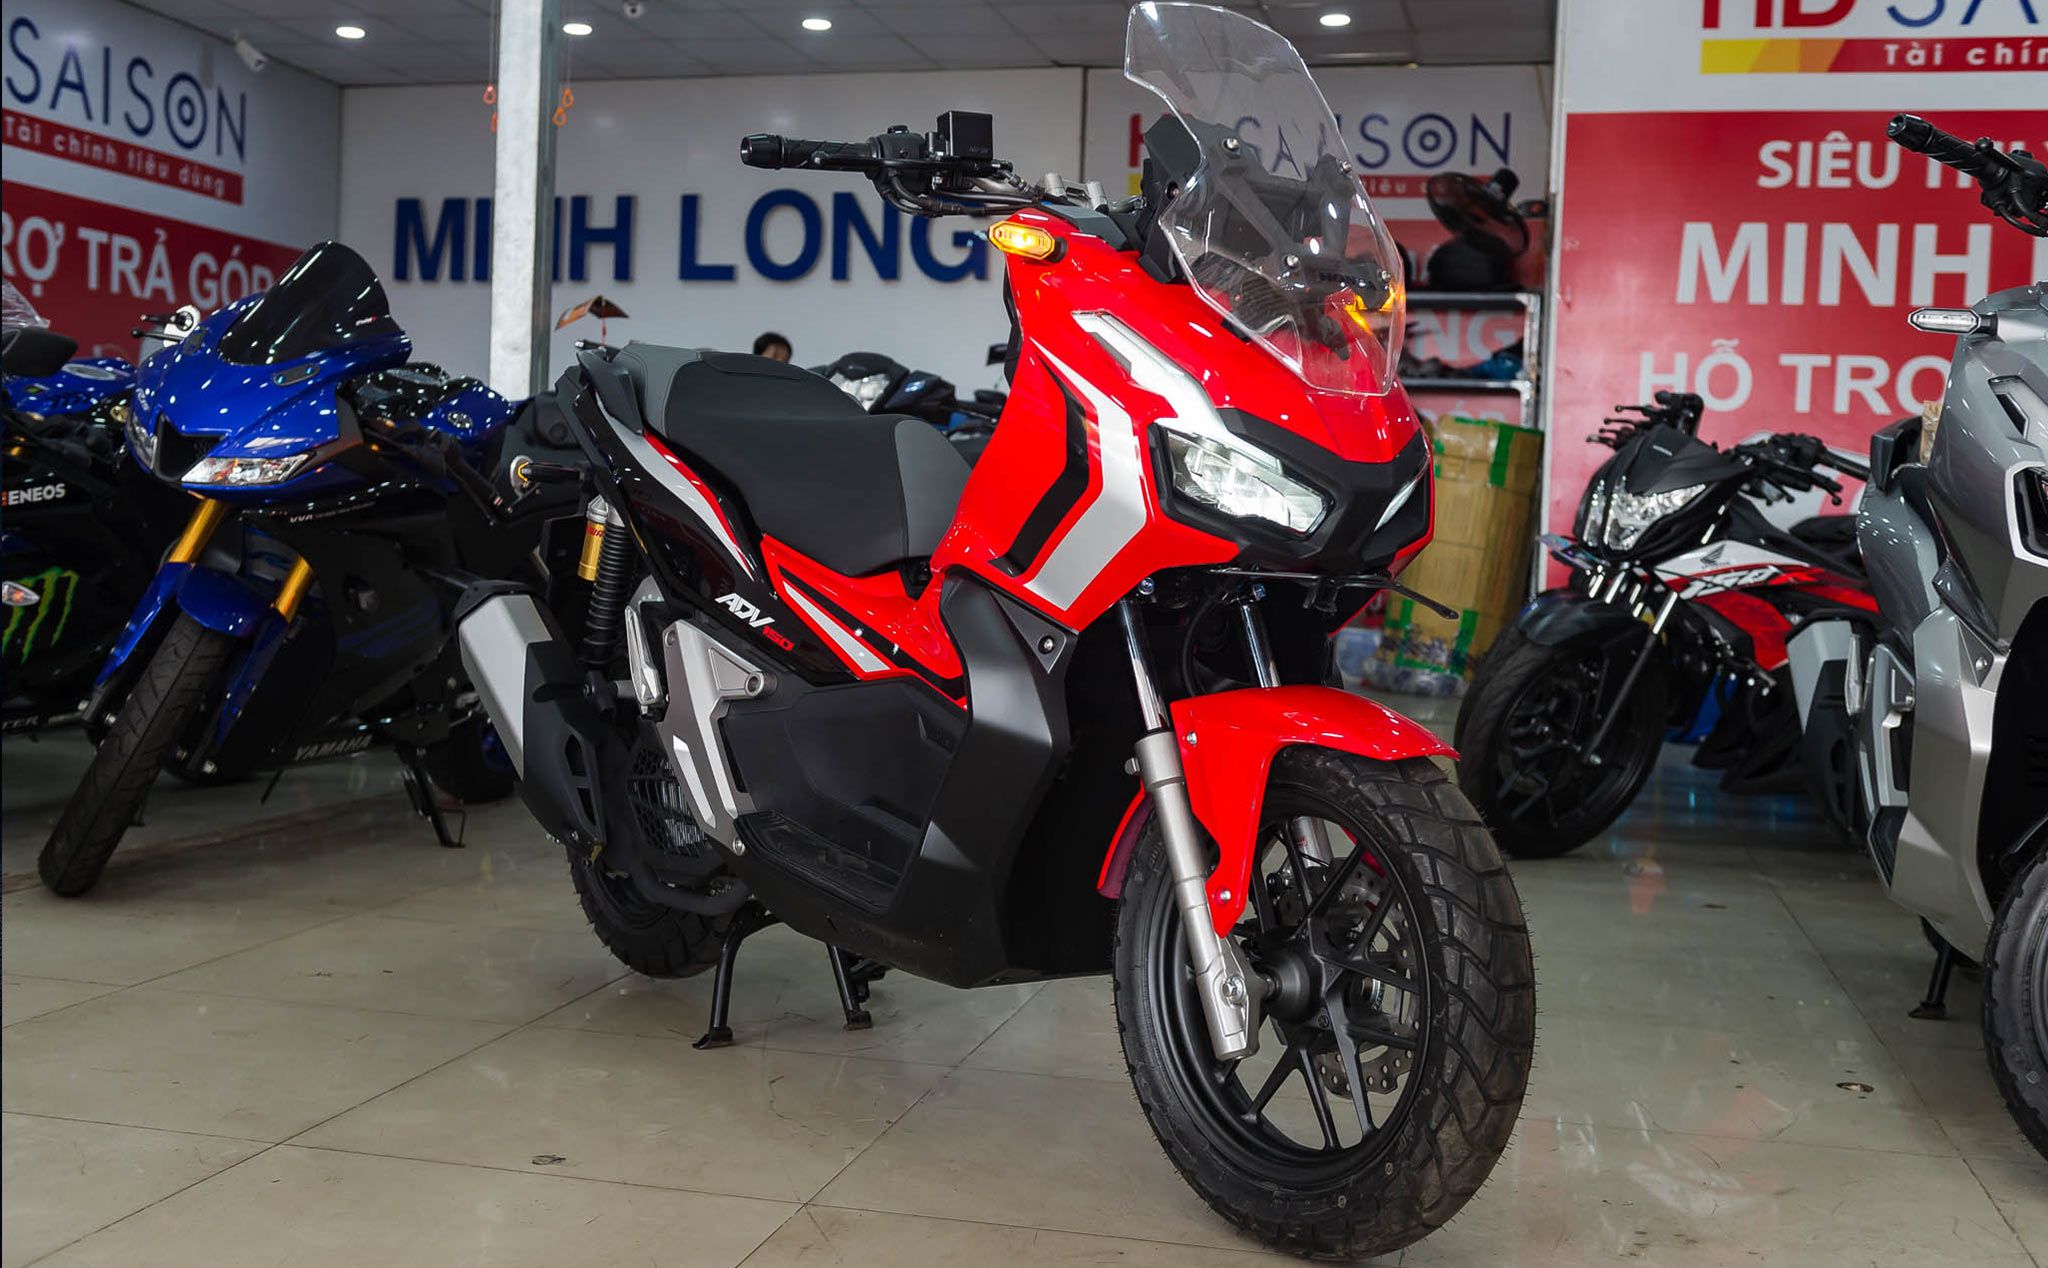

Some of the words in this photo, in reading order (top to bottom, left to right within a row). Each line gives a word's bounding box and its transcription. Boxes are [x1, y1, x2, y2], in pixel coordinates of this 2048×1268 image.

[5, 16, 247, 163] SAISON
[1884, 40, 1944, 66] Tài
[4, 116, 42, 145] Tài
[53, 132, 118, 165] chính
[127, 151, 170, 179] tiêu
[178, 163, 225, 199] dùng
[1757, 130, 1900, 189] SIÊU
[77, 227, 176, 304] TRẢ
[678, 188, 990, 284] LONG
[1674, 222, 1993, 307] MINH
[1637, 338, 1754, 413] HỖ
[8, 483, 66, 506] ENEOS
[714, 592, 776, 629] ADV
[762, 624, 795, 651] 150
